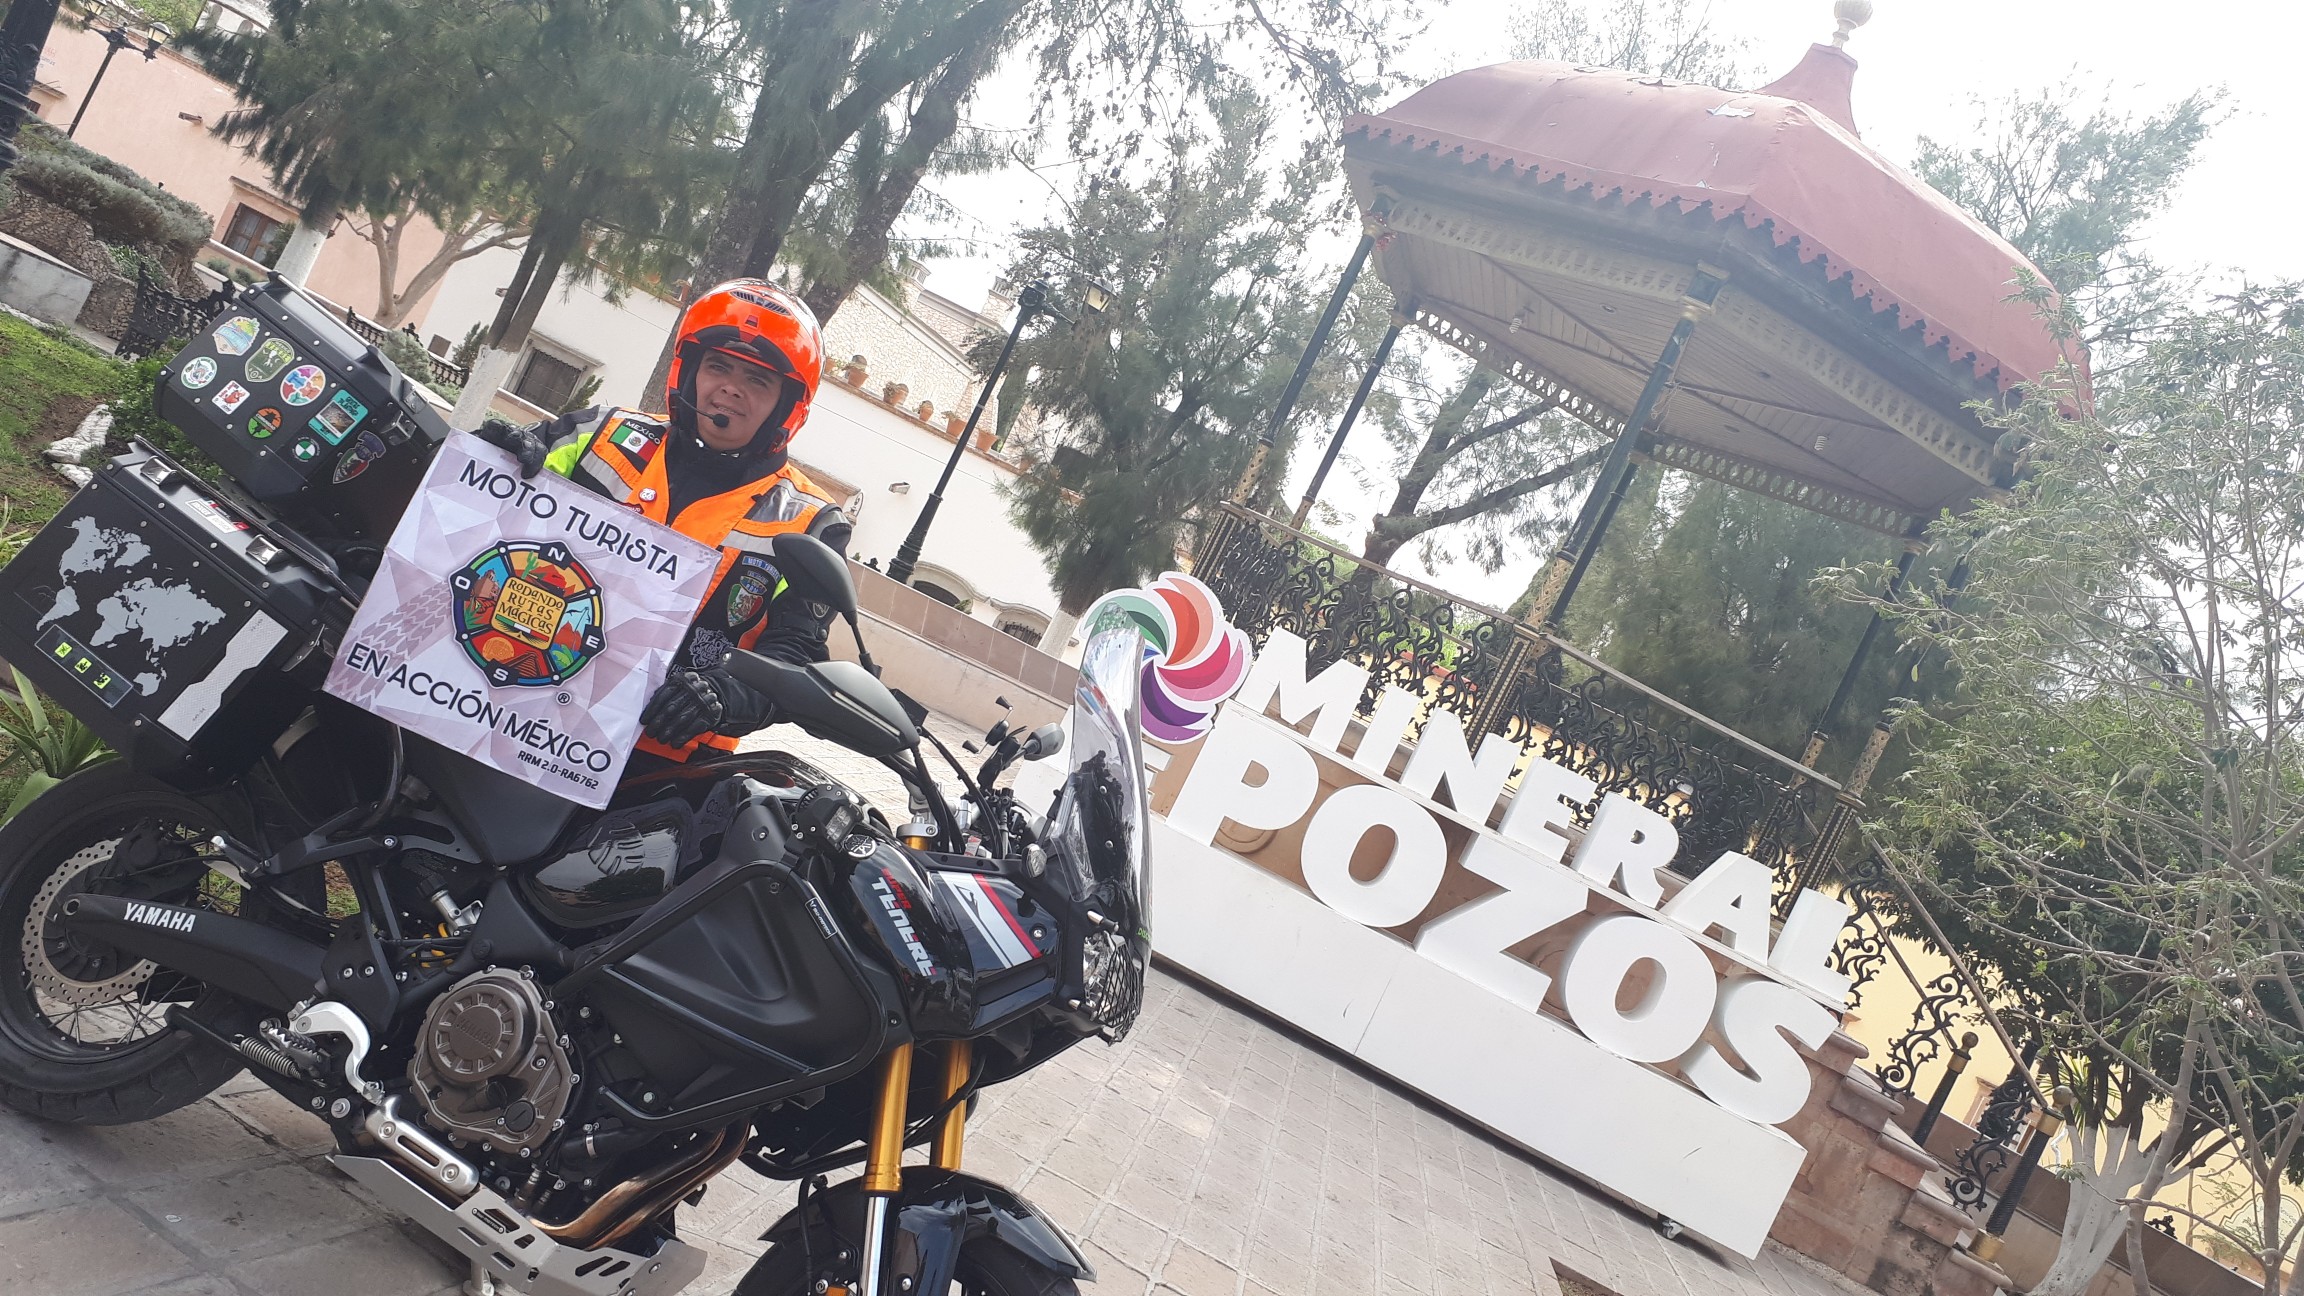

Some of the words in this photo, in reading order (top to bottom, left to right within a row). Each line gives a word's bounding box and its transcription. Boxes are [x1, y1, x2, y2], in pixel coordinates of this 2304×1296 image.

[625, 421, 660, 445] MEXICO
[459, 459, 558, 519] MOTO
[565, 506, 679, 580] TURISTA
[547, 547, 565, 561] N
[493, 668, 508, 682] S
[346, 643, 389, 678] EN
[387, 663, 504, 729] ACCIÓN
[502, 713, 611, 772] MÉXICO
[518, 750, 541, 767] RRM
[540, 759, 599, 790] 2.0-RA6762
[1237, 628, 1855, 998] MINERAL
[881, 867, 912, 909] SUPER
[123, 902, 197, 933] YAMAHA
[1168, 700, 1845, 1126] POZOS
